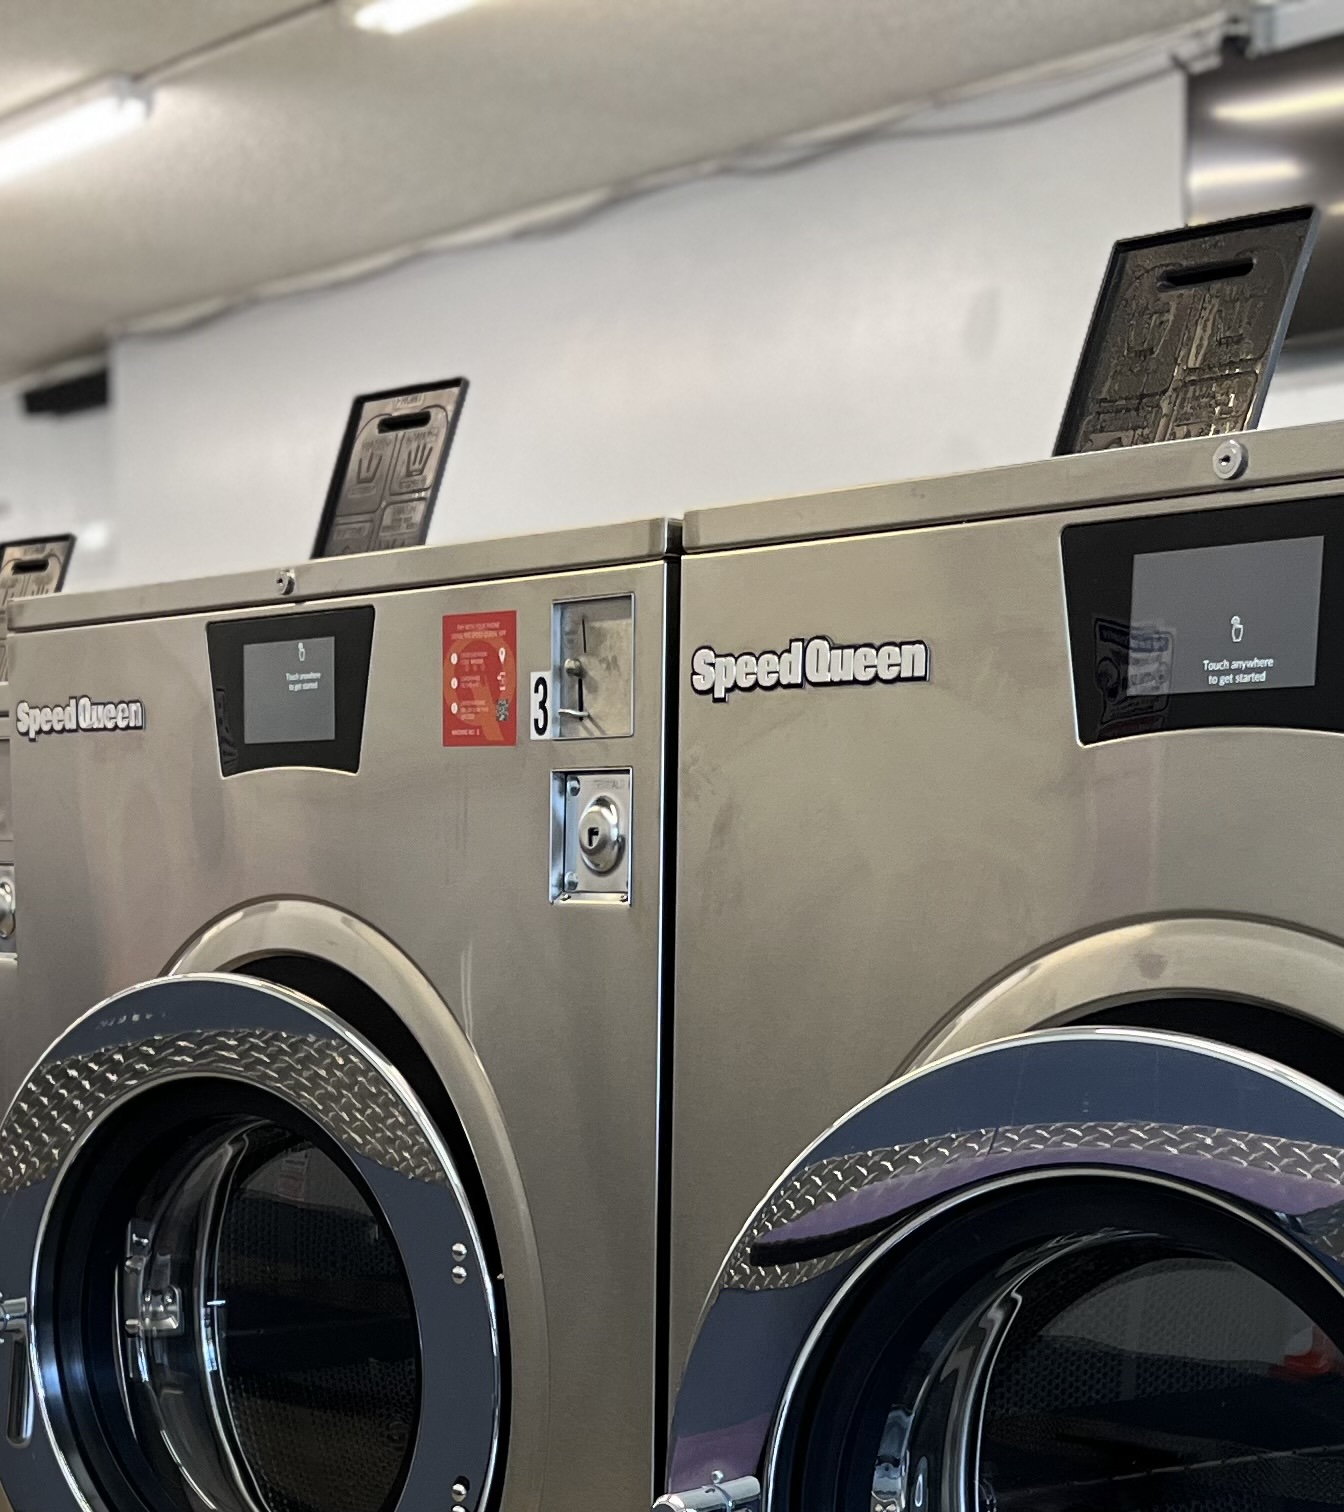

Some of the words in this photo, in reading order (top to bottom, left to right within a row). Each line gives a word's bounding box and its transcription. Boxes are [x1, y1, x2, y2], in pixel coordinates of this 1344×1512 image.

[691, 638, 804, 702] Speed
[805, 635, 929, 687] Queen
[1202, 659, 1230, 671] Touch
[1230, 657, 1274, 670] anywhere
[1208, 675, 1218, 685] to
[1219, 673, 1233, 686] get
[1235, 670, 1266, 683] started
[17, 696, 77, 742] Speed
[78, 694, 144, 731] Queen
[534, 676, 548, 736] 3
